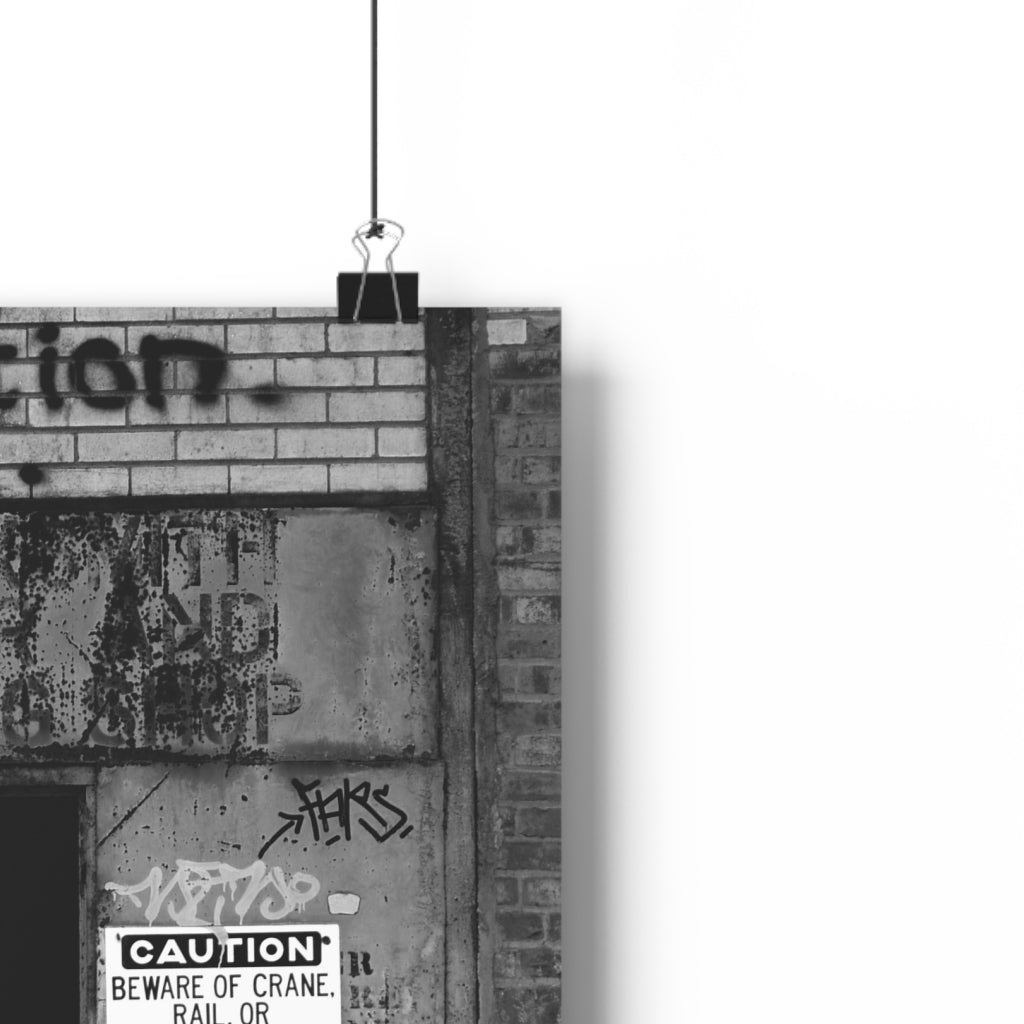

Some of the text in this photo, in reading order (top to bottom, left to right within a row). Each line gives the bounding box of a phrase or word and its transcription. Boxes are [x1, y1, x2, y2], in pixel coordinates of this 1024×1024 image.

[129, 935, 315, 965] CAUTION
[111, 975, 205, 1001] BEWARE
[213, 974, 242, 999] OF
[253, 972, 335, 999] CRANE,
